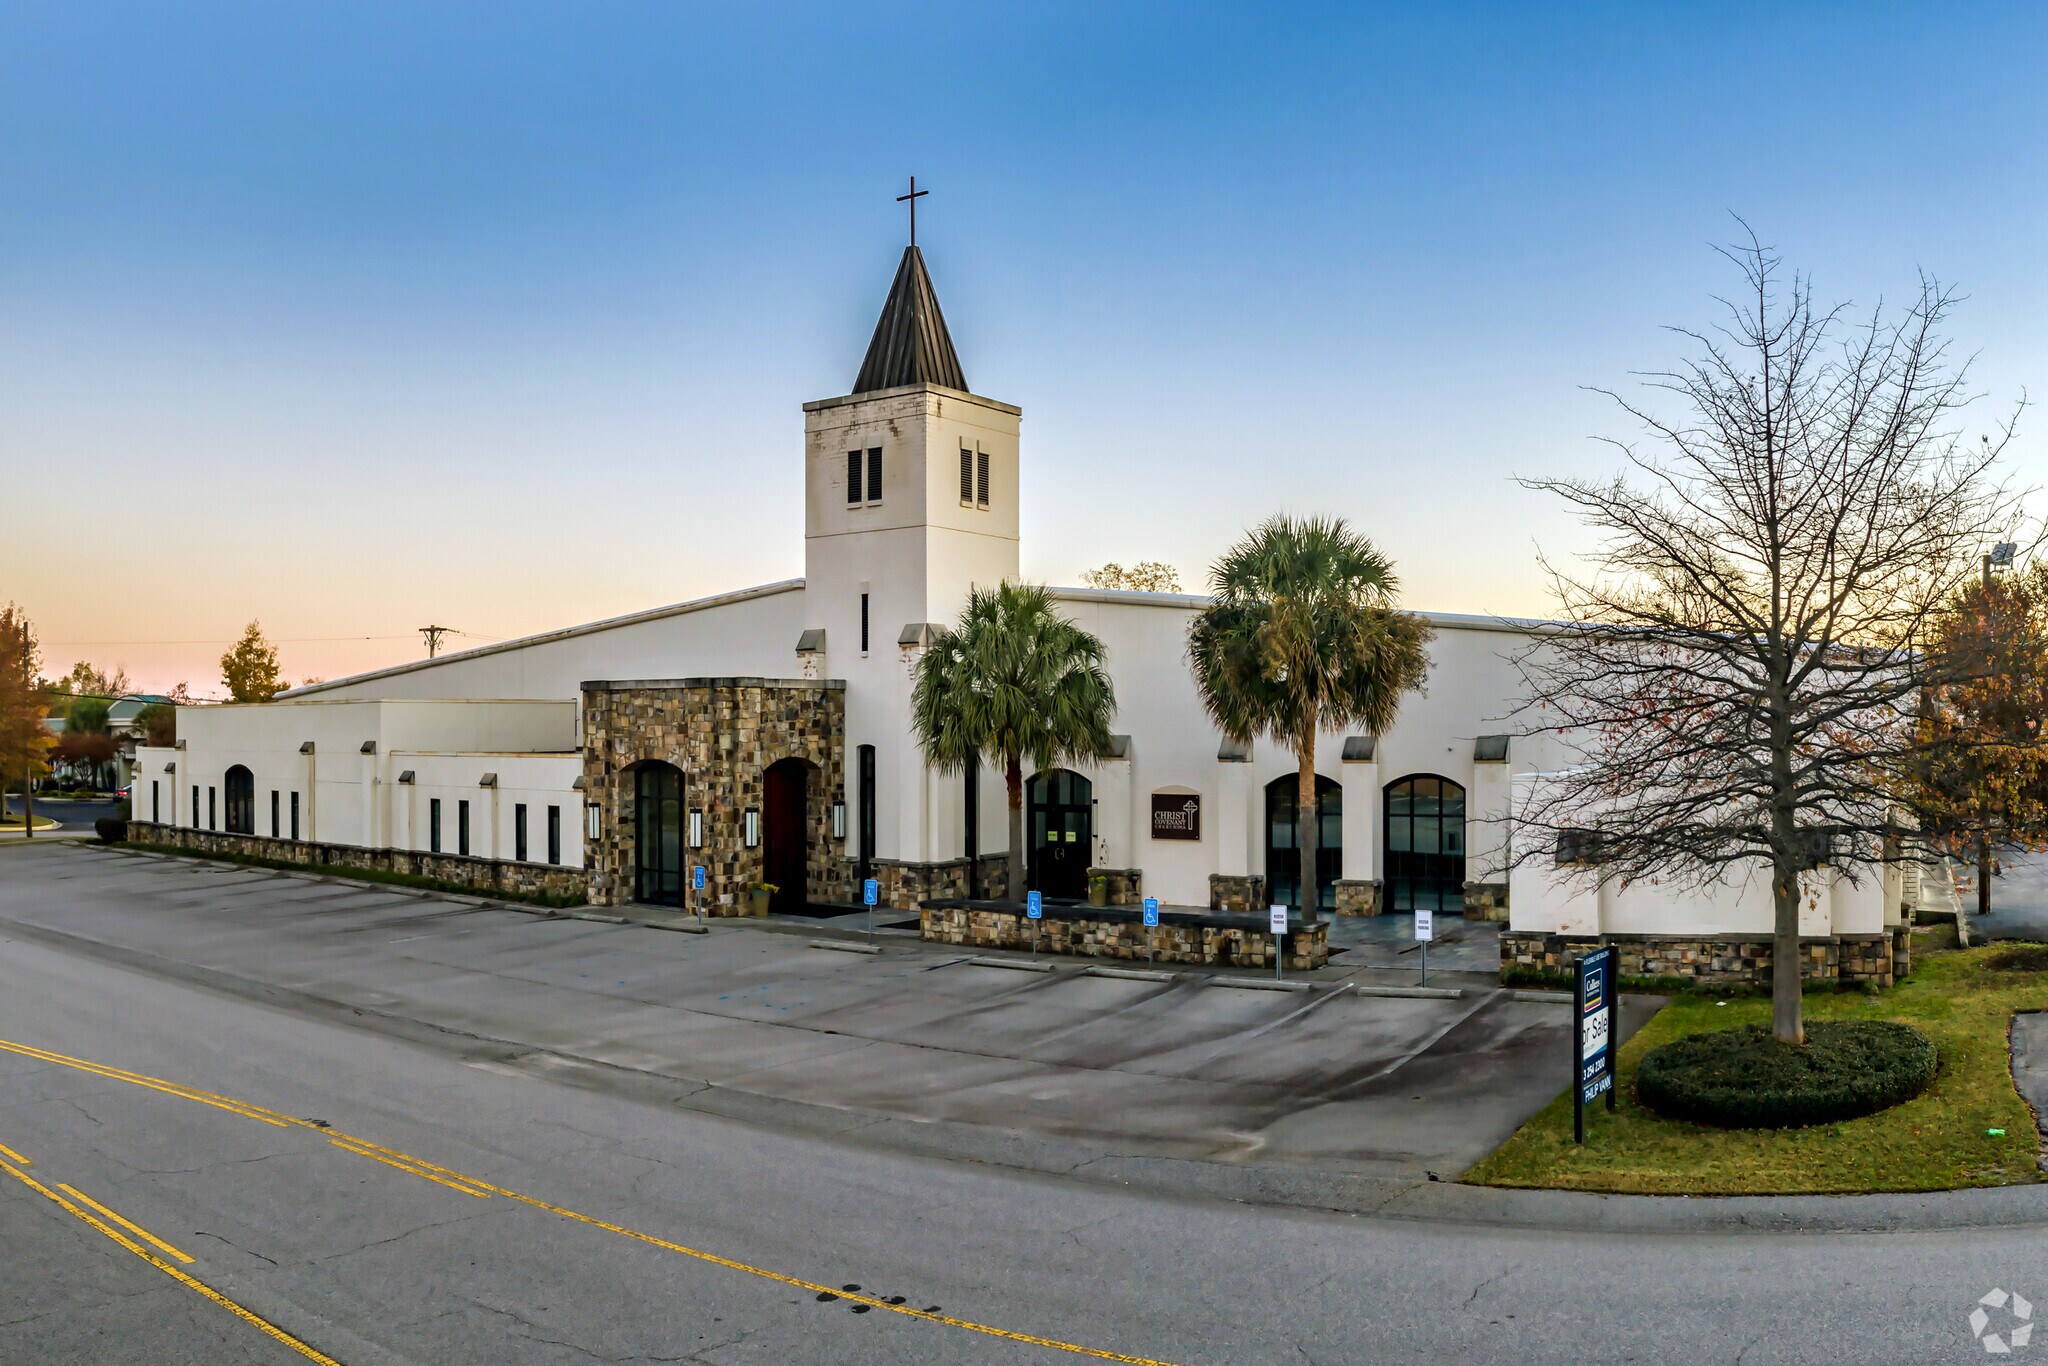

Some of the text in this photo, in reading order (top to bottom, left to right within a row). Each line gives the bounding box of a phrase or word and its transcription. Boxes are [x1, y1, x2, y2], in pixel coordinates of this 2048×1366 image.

[1154, 811, 1186, 820] CHRIST
[1586, 979, 1600, 991] Colliers
[1592, 1013, 1608, 1039] Sale
[1595, 1056, 1605, 1072] 2300
